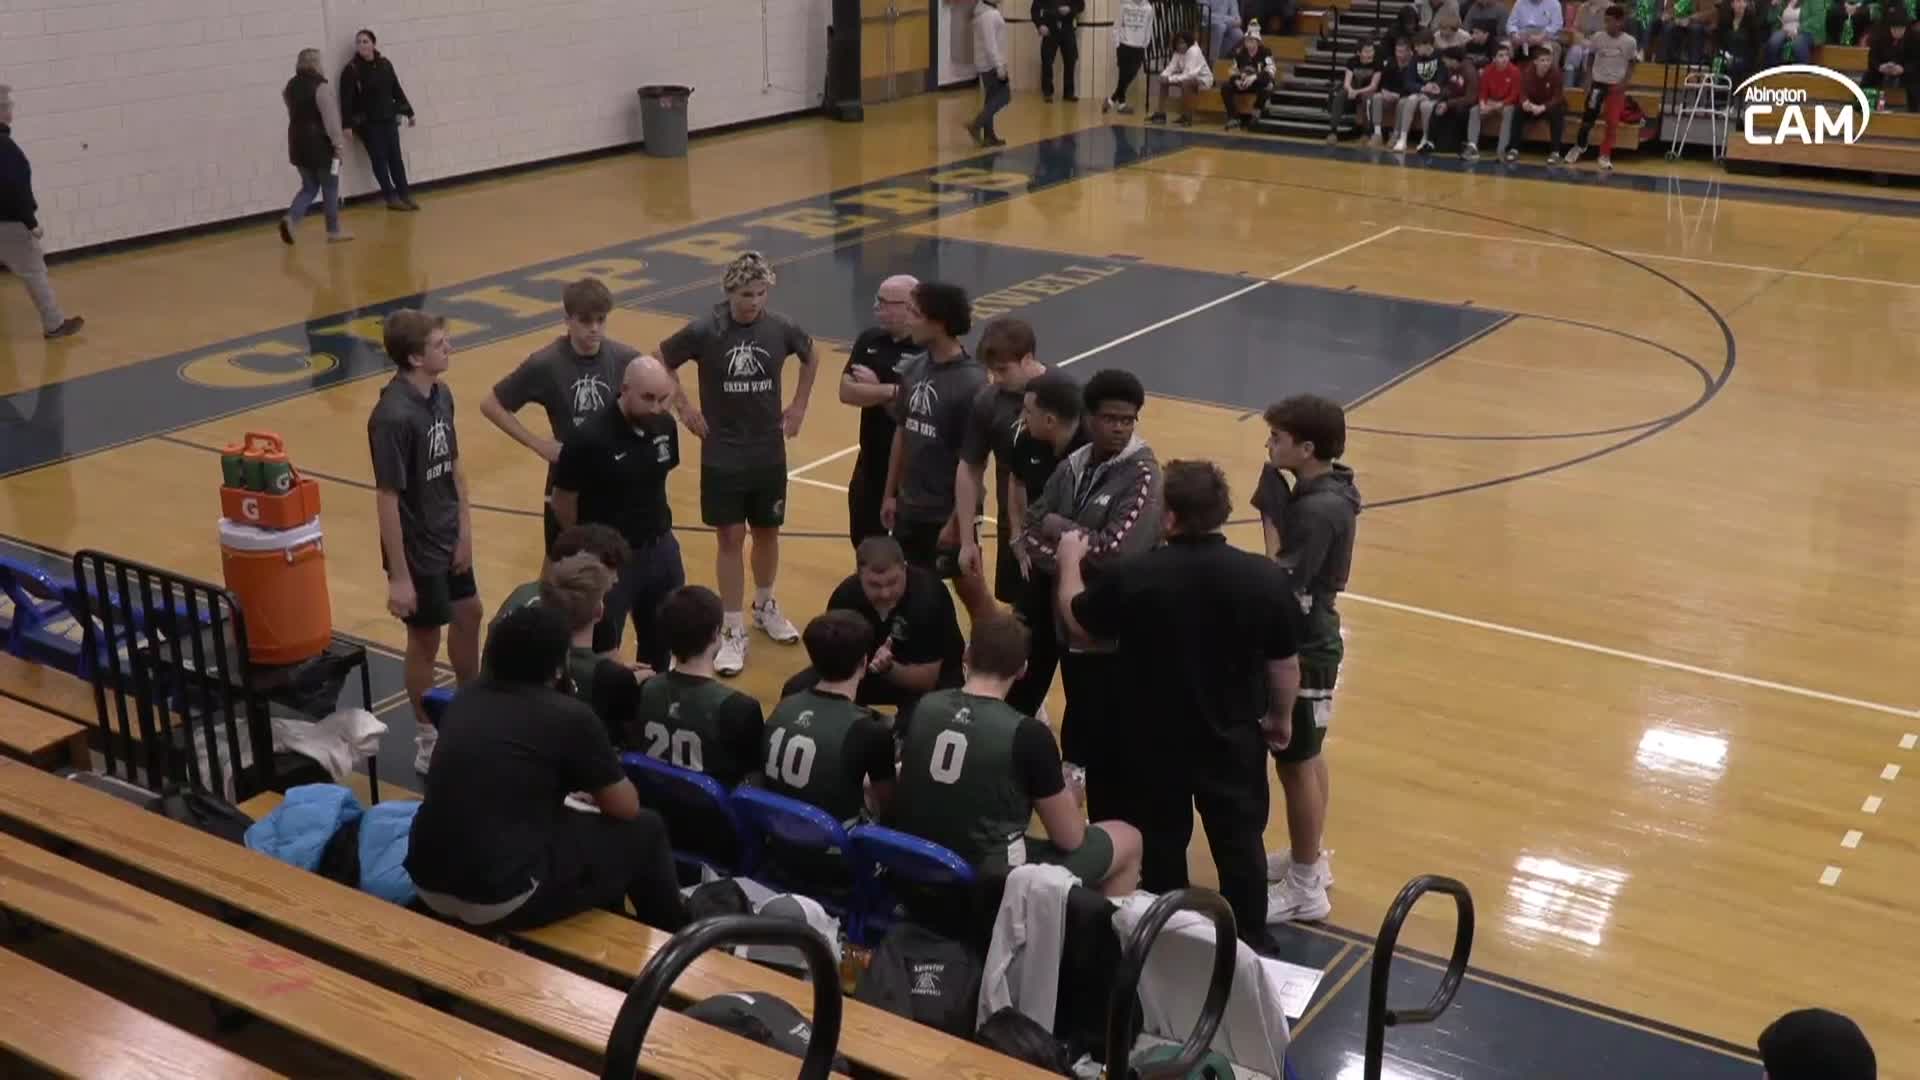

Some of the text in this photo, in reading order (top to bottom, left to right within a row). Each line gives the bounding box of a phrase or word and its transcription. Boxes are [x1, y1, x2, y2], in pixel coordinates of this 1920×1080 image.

[723, 381, 749, 392] GREEN
[276, 473, 290, 490] G
[242, 498, 260, 520] G
[643, 721, 704, 772] 20
[765, 727, 817, 789] 10
[929, 729, 969, 784] 0
